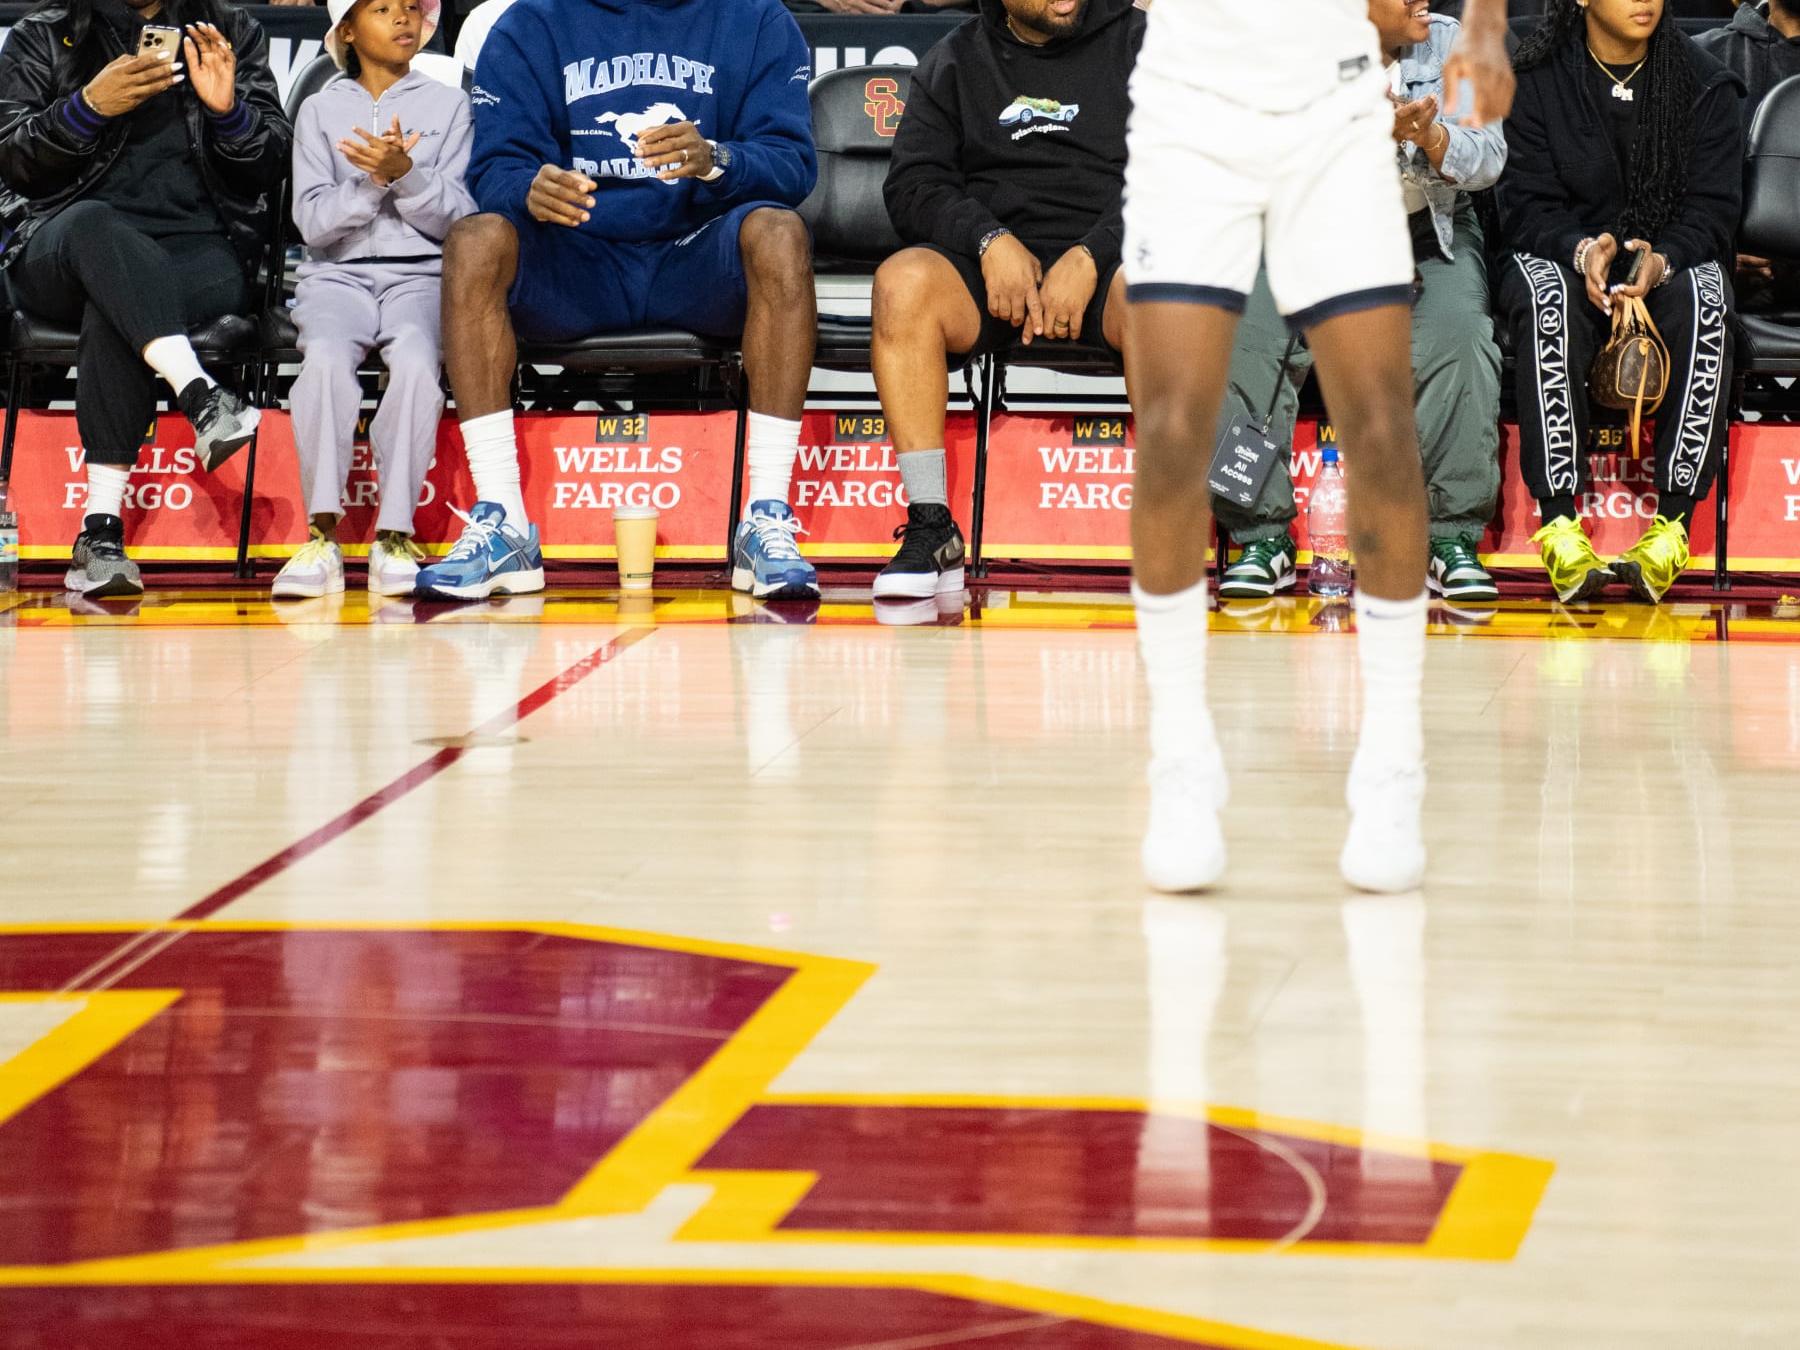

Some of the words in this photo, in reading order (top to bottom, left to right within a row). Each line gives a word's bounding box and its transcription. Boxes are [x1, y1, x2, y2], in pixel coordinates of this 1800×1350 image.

[599, 418, 617, 436] W
[622, 418, 646, 436] 32
[838, 418, 857, 435] W
[861, 418, 885, 435] 33
[1075, 421, 1094, 438] W
[1099, 421, 1124, 439] 34
[1319, 425, 1336, 442] W
[553, 446, 683, 474] WELLS
[797, 445, 900, 472] WELL
[1233, 460, 1248, 473] All
[1220, 464, 1253, 486] Access
[62, 482, 193, 510] FRGO
[552, 481, 681, 510] FARGO
[1038, 482, 1135, 511] FARG
